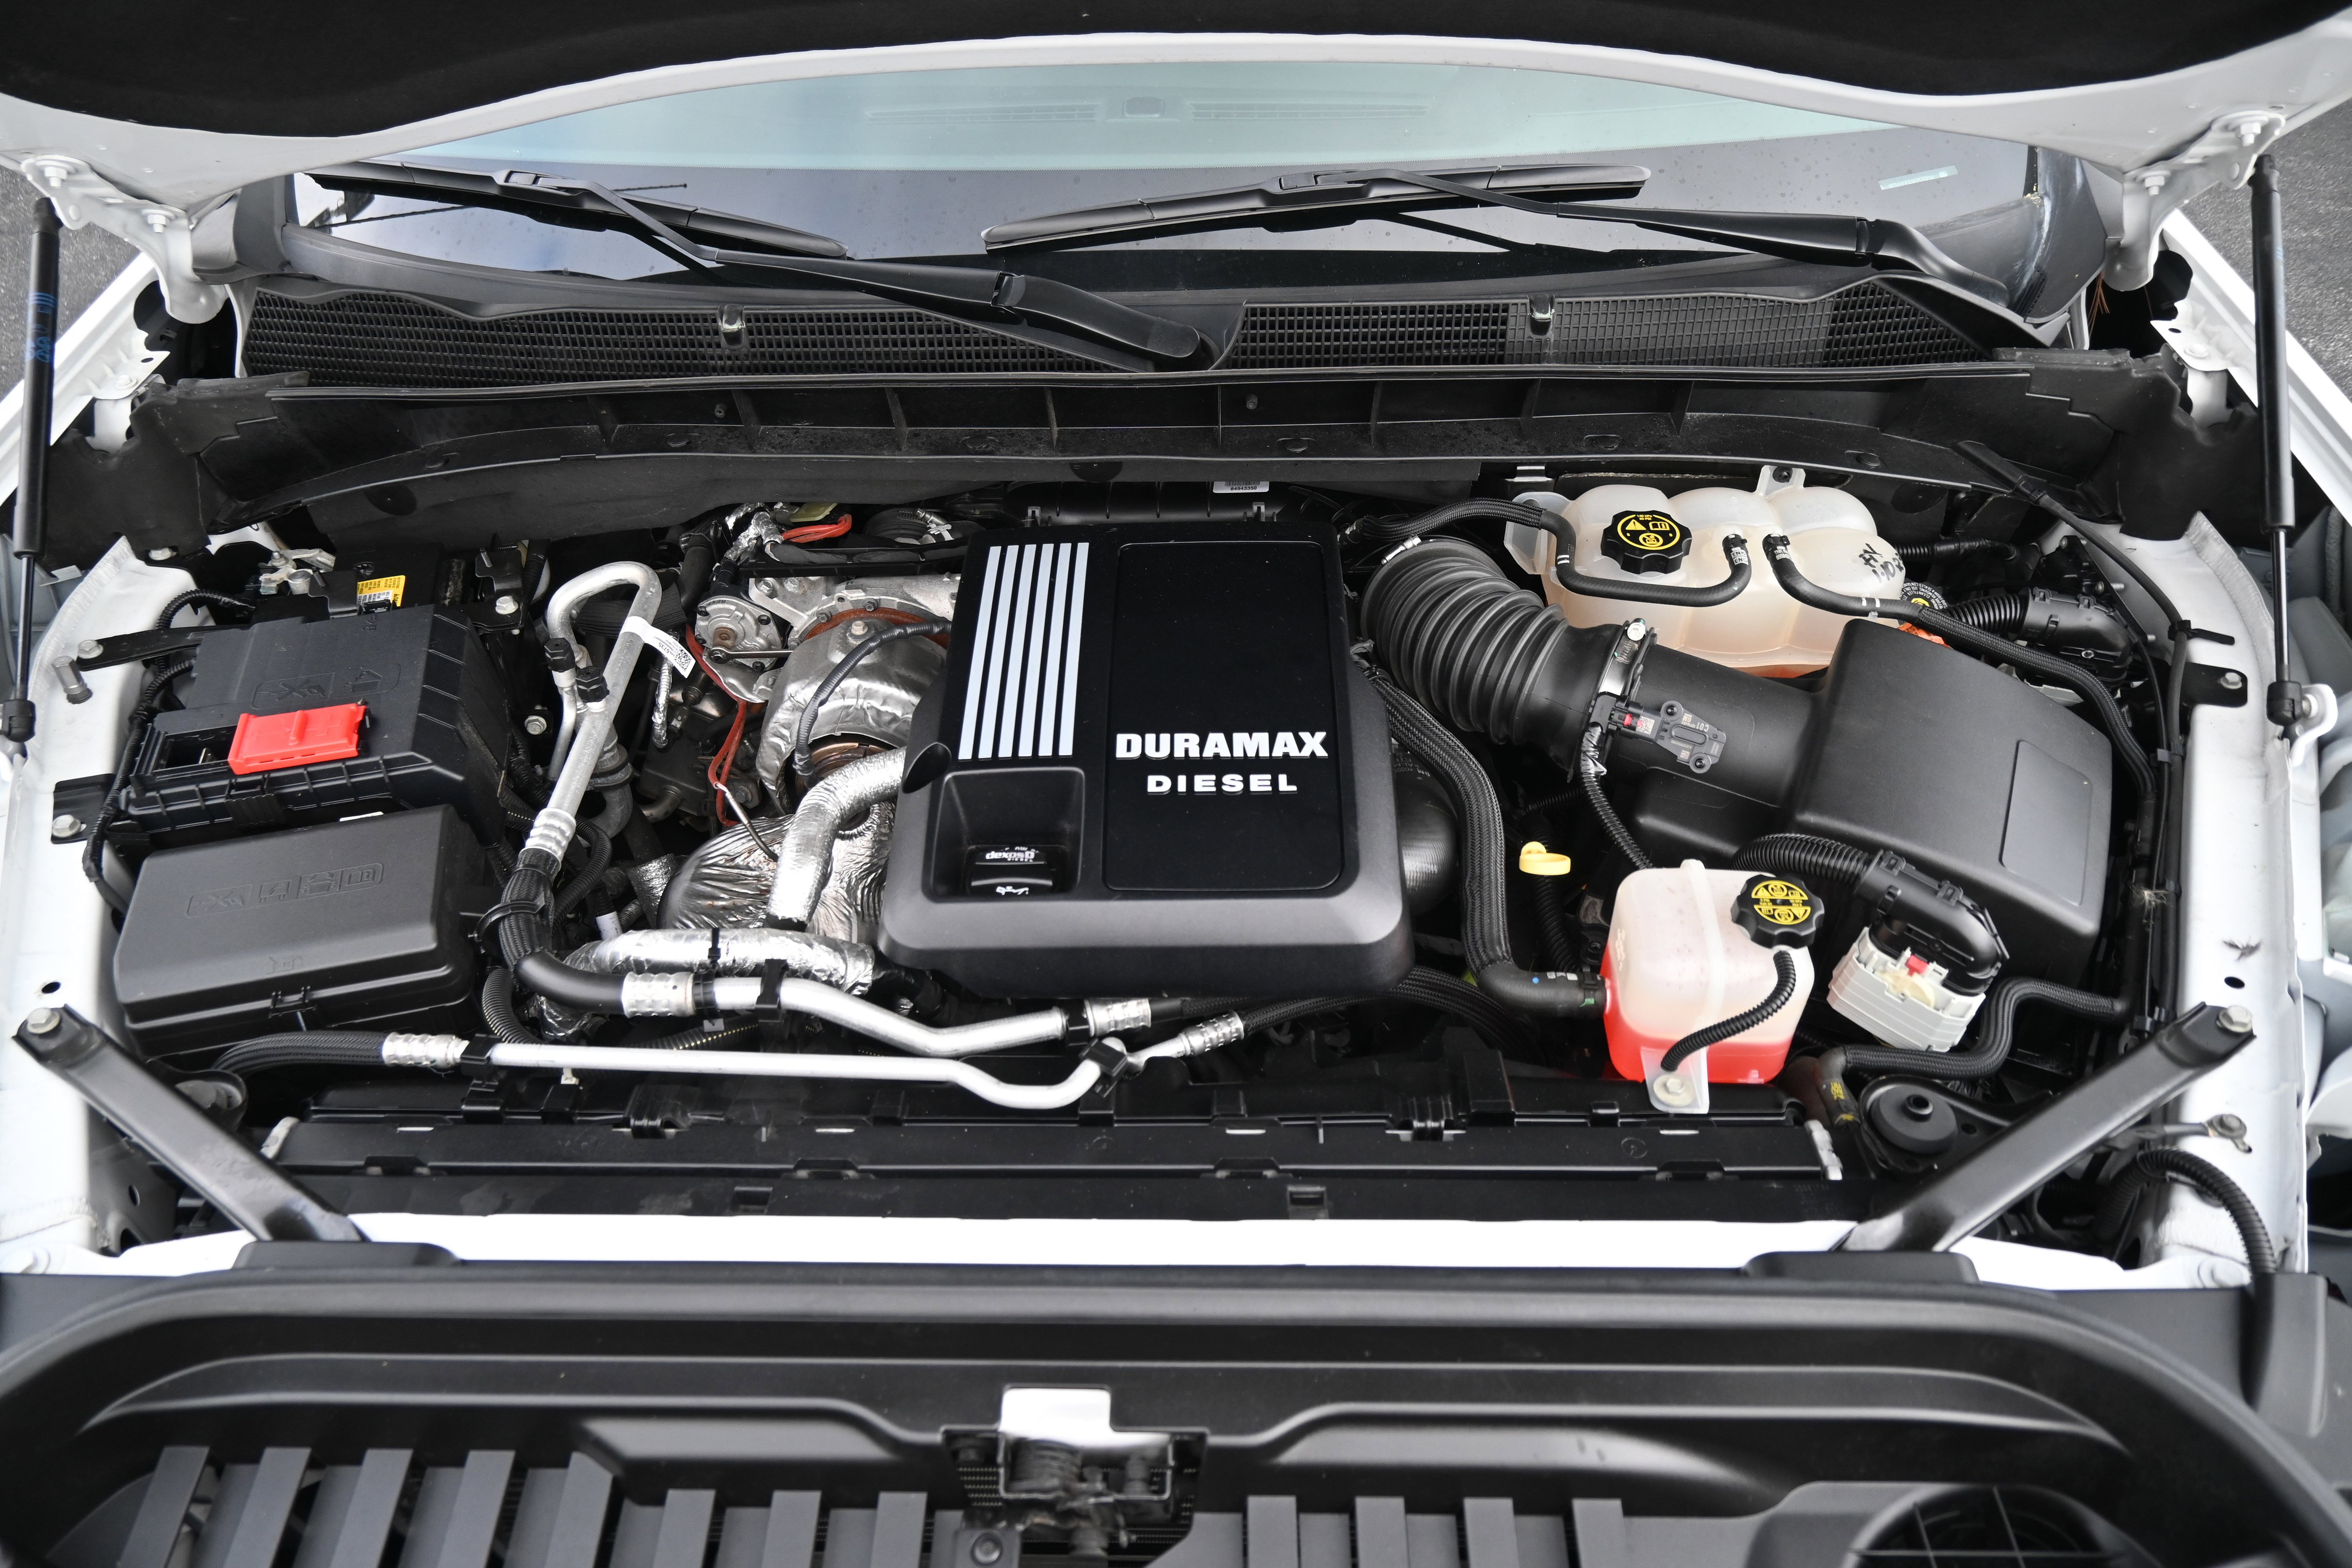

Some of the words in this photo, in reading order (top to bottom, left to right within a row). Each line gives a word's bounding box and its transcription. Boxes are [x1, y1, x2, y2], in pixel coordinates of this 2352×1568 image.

[658, 642, 670, 653] 6735
[1116, 732, 1328, 760] DURAMAX
[1147, 773, 1297, 794] DIESEL
